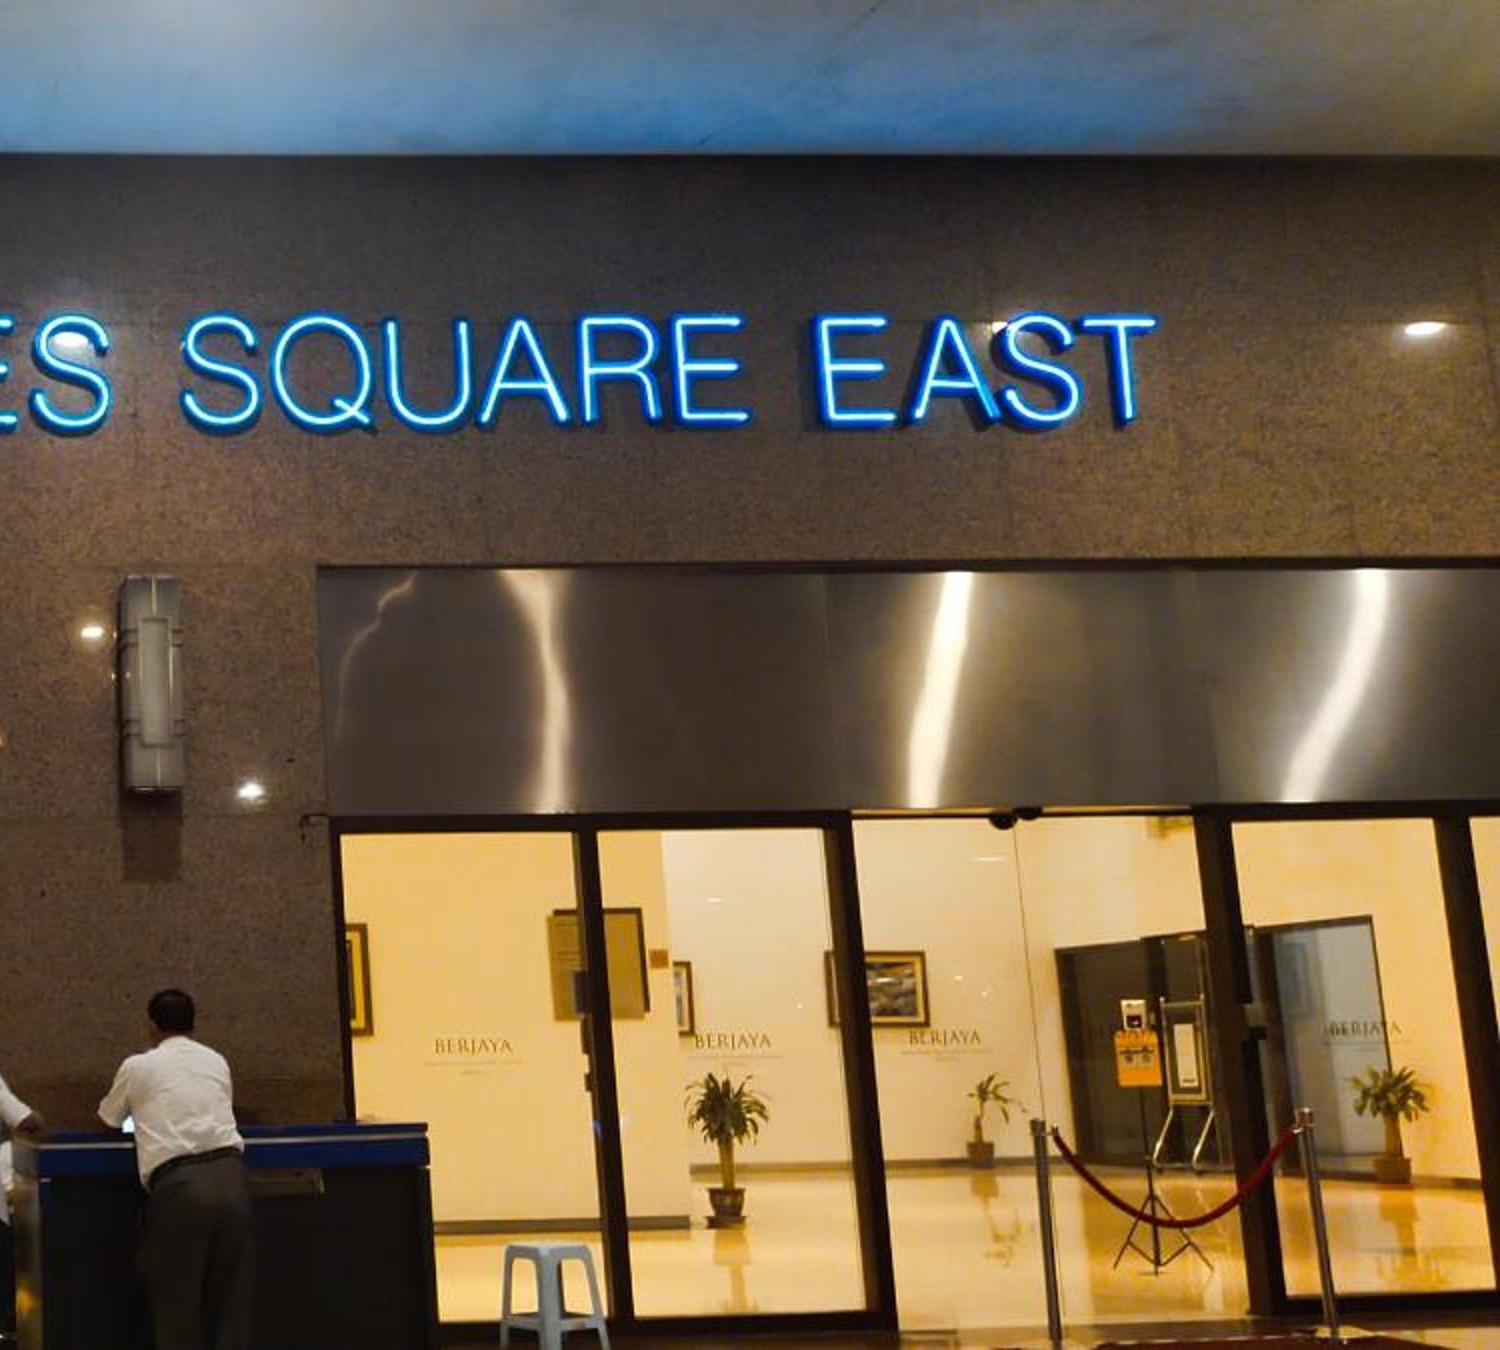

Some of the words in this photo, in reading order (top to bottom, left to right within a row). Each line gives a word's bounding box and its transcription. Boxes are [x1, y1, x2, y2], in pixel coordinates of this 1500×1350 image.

[181, 313, 752, 434] SQUARE
[815, 312, 1158, 430] EAST
[909, 1029, 981, 1046] BERJAYA
[1331, 1021, 1403, 1037] BERJAA
[435, 1038, 513, 1055] BERJAYA
[695, 1033, 771, 1050] BERJAYA
